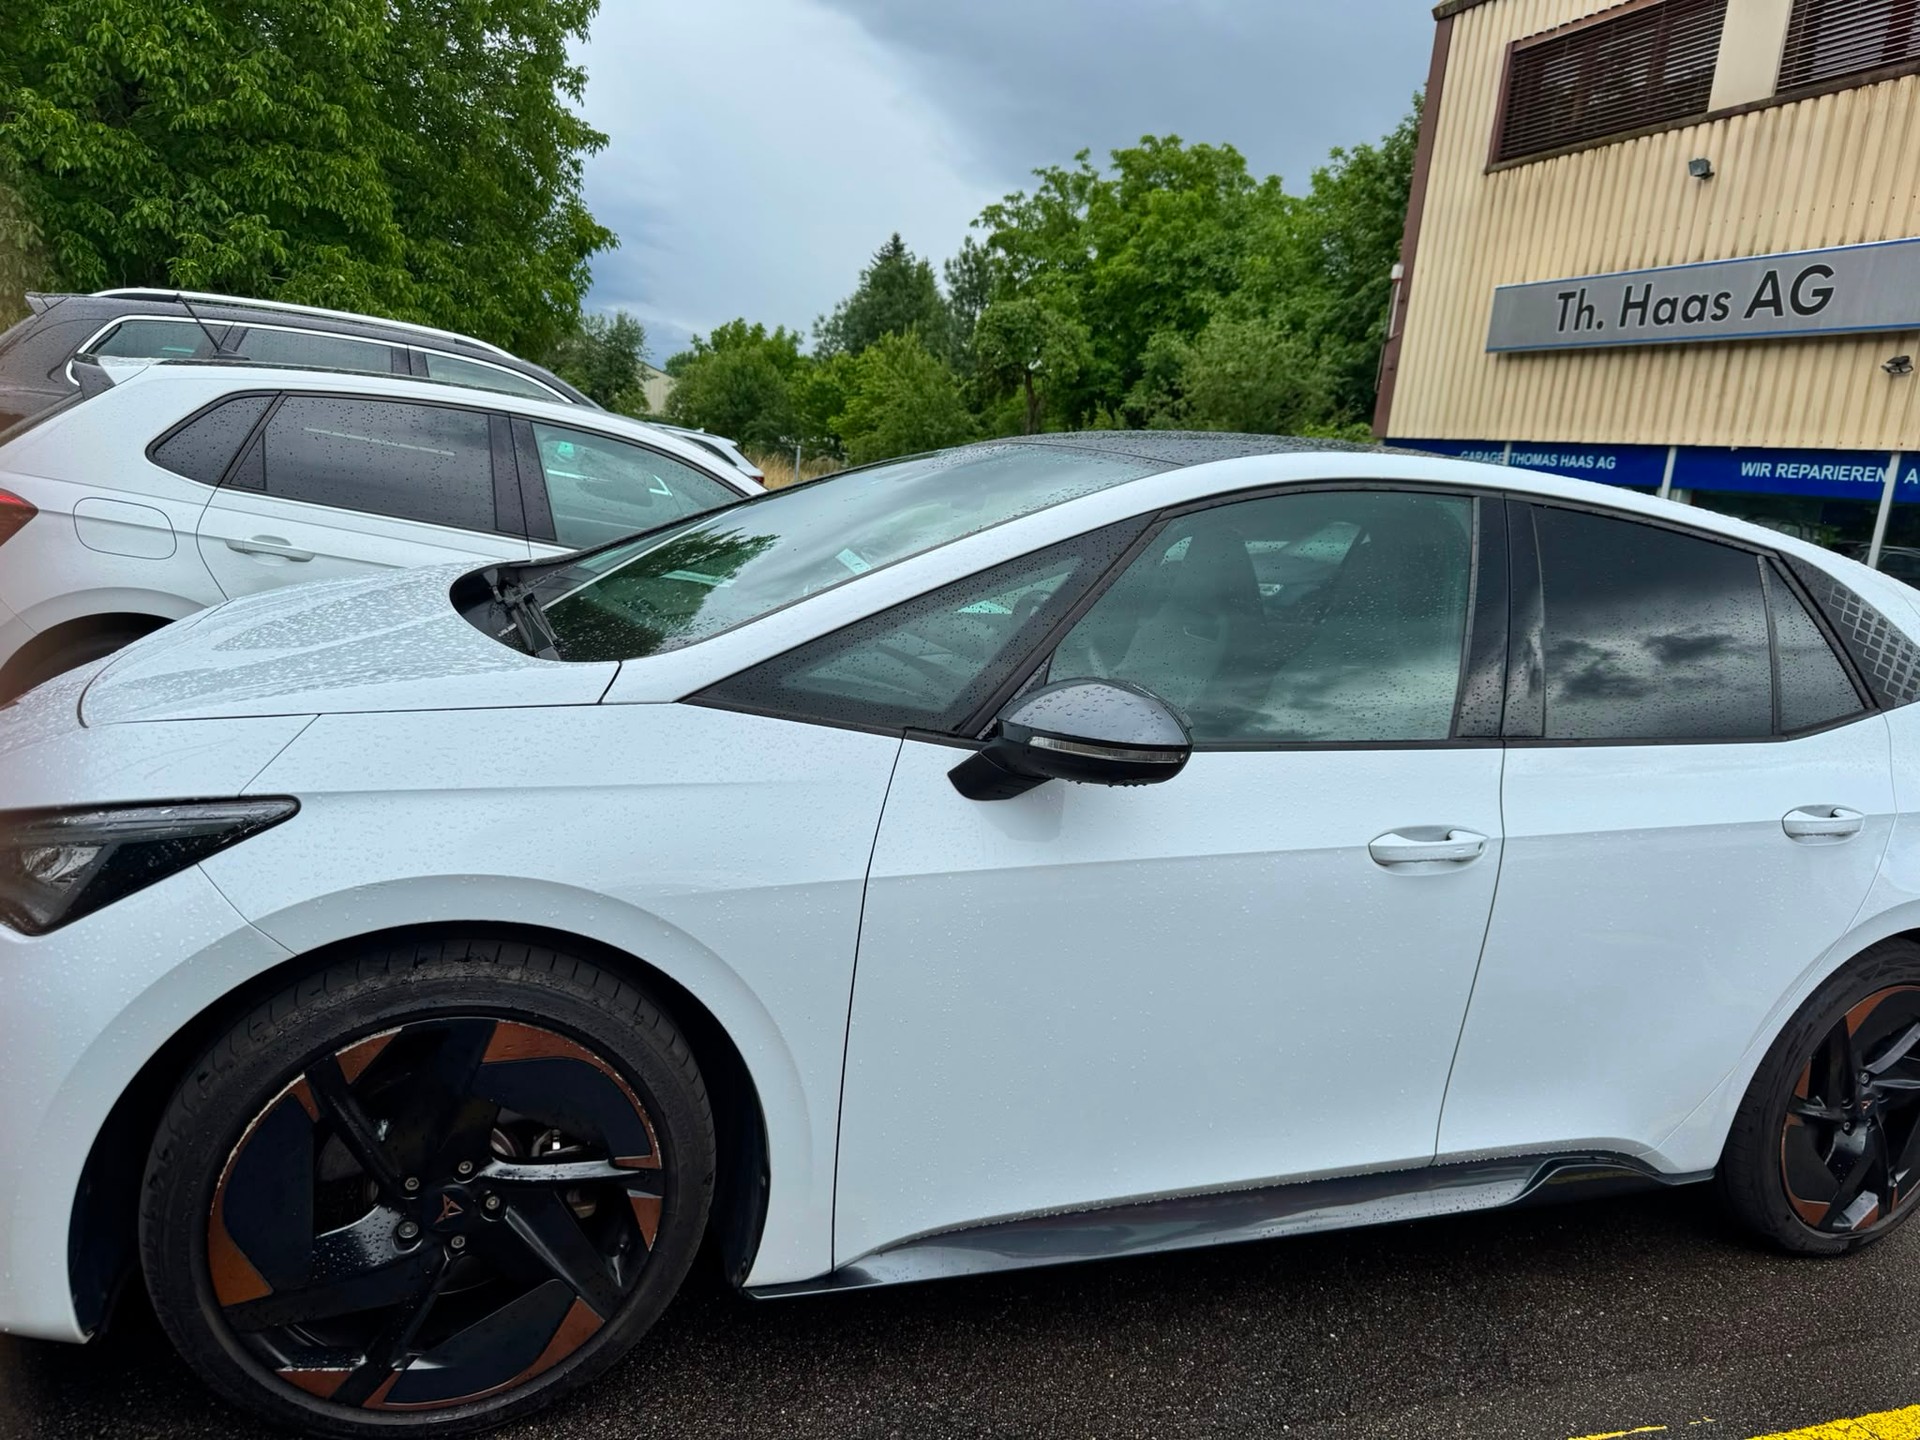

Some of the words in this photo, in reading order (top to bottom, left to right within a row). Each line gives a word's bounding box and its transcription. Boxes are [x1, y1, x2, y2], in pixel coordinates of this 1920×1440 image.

[1558, 287, 1604, 332] Th.
[1618, 283, 1732, 328] Haas
[1743, 263, 1835, 319] AG
[1510, 452, 1558, 467] THOMAS
[1560, 454, 1595, 469] HAAS
[1596, 456, 1617, 470] AG
[1741, 461, 1772, 478] WIR
[1775, 463, 1889, 483] REPARIEREN
[1903, 468, 1920, 485] A
